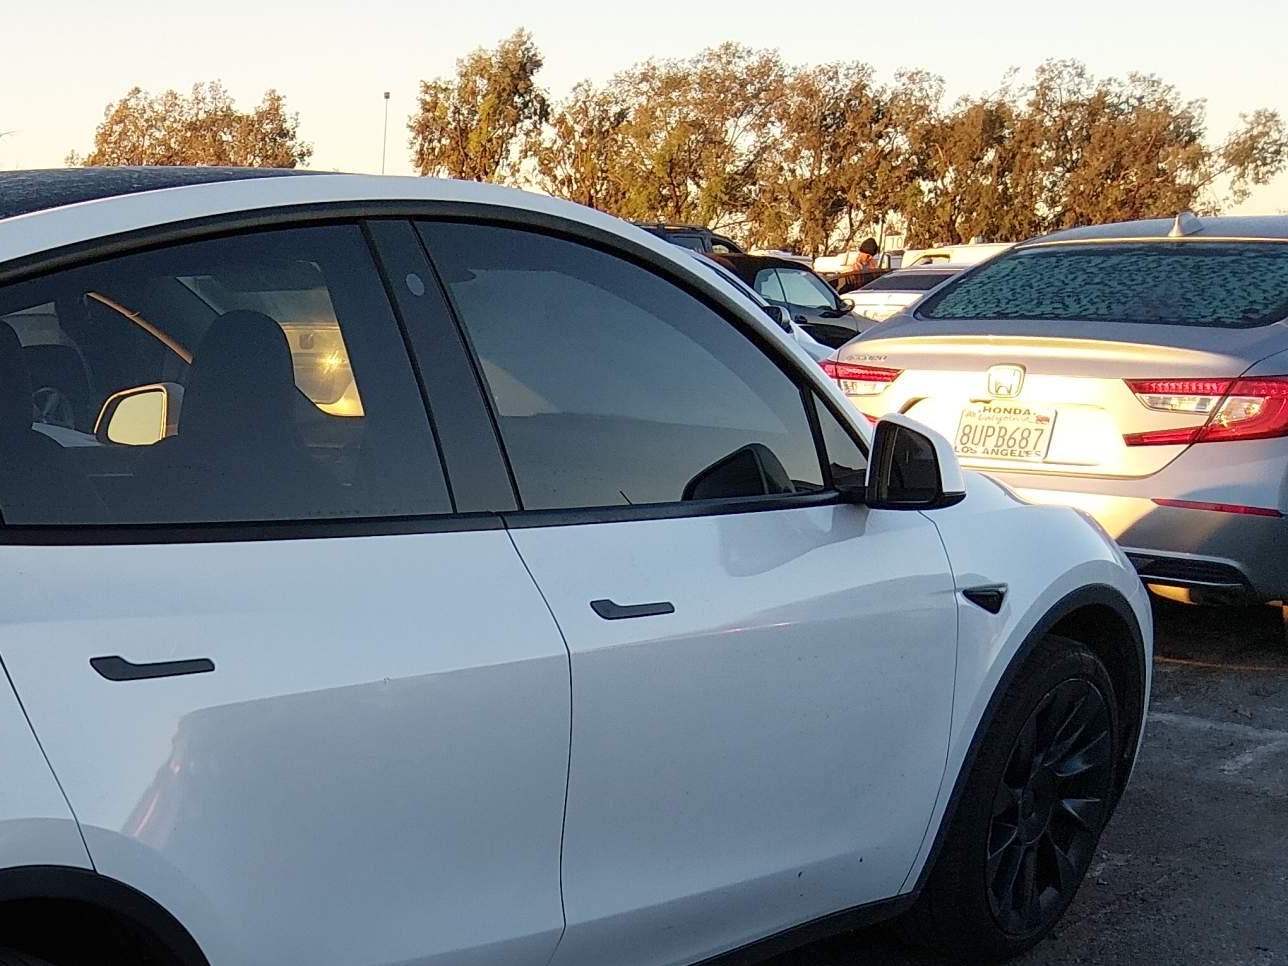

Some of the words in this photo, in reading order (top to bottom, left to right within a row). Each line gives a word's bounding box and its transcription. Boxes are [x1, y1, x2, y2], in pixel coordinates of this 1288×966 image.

[982, 405, 1031, 416] HONDA
[959, 423, 1044, 451] 8UPB687
[954, 445, 977, 455] LOS
[981, 447, 1041, 458] ANGELES
